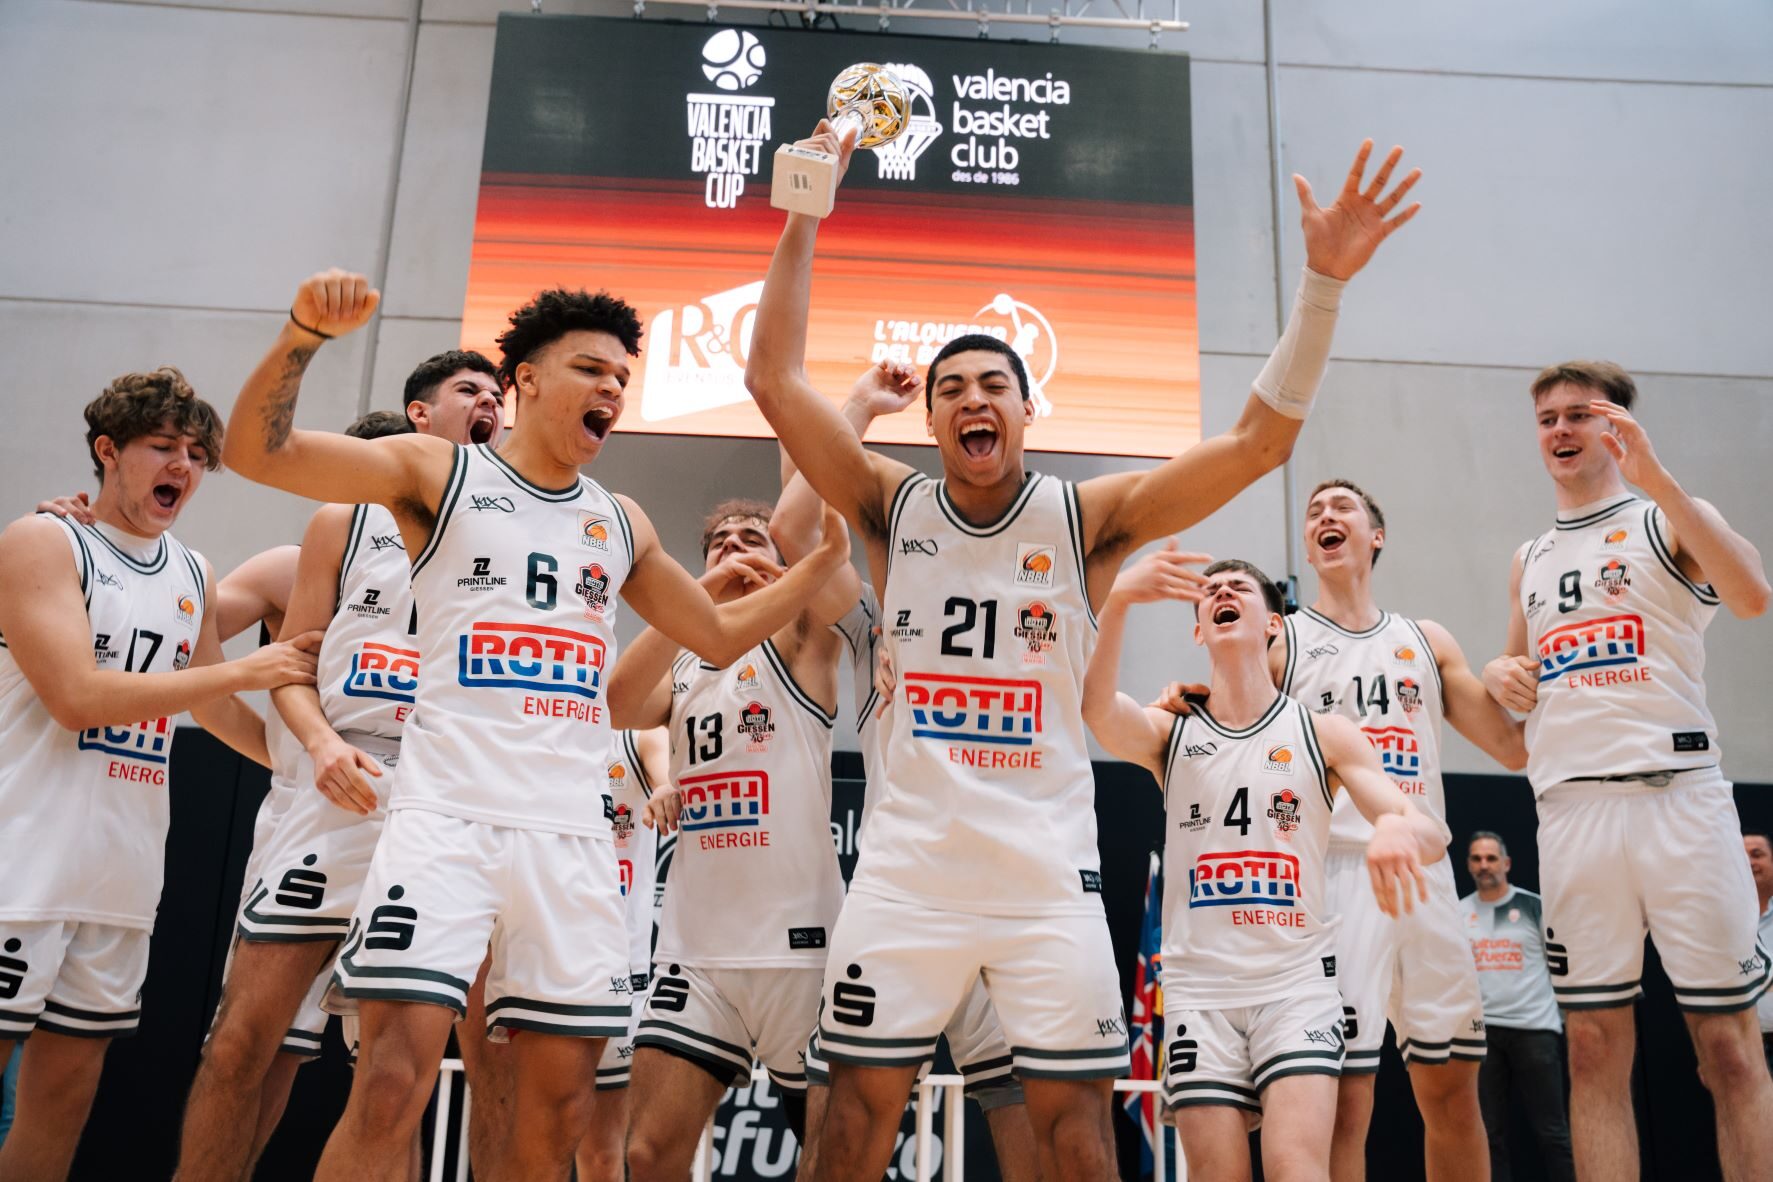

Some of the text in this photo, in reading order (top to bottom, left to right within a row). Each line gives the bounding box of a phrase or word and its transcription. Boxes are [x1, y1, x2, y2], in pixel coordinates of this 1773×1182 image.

[953, 68, 1070, 105] valencia
[687, 102, 771, 141] VALENCIA
[953, 101, 1051, 139] basket
[691, 137, 763, 175] BASKET
[951, 136, 1019, 170] club
[705, 173, 745, 209] CUP
[951, 169, 972, 183] des
[973, 171, 989, 184] de
[871, 342, 913, 365] DEL
[581, 534, 609, 552] NBBL
[457, 576, 508, 588] PRINTLINE
[526, 551, 559, 611] 6
[1017, 571, 1049, 584] NBBL
[1558, 569, 1583, 614] 9
[347, 603, 391, 616] PRINTLINE
[575, 583, 609, 606] GIESSEN
[941, 596, 998, 660] 21
[1014, 627, 1057, 642] GIESSEN
[124, 627, 164, 673] 17
[471, 634, 600, 688] ROTH
[1539, 624, 1635, 671] ROTH
[1568, 666, 1652, 689] ENERGIE
[523, 696, 602, 724] ENERGIE
[905, 685, 1033, 733] ROTH
[1352, 674, 1389, 717] 14
[686, 712, 723, 765] 13
[737, 722, 775, 734] GIESSEN
[949, 747, 1042, 769] ENERGIE
[1264, 760, 1291, 773] NBBL
[1179, 816, 1212, 830] PRINTLINE
[1223, 786, 1251, 836] 4
[1267, 808, 1301, 824] GIESSEN
[700, 831, 770, 850] ENERGIE
[1194, 861, 1294, 897] ROTH
[1232, 910, 1306, 928] ENERGIE
